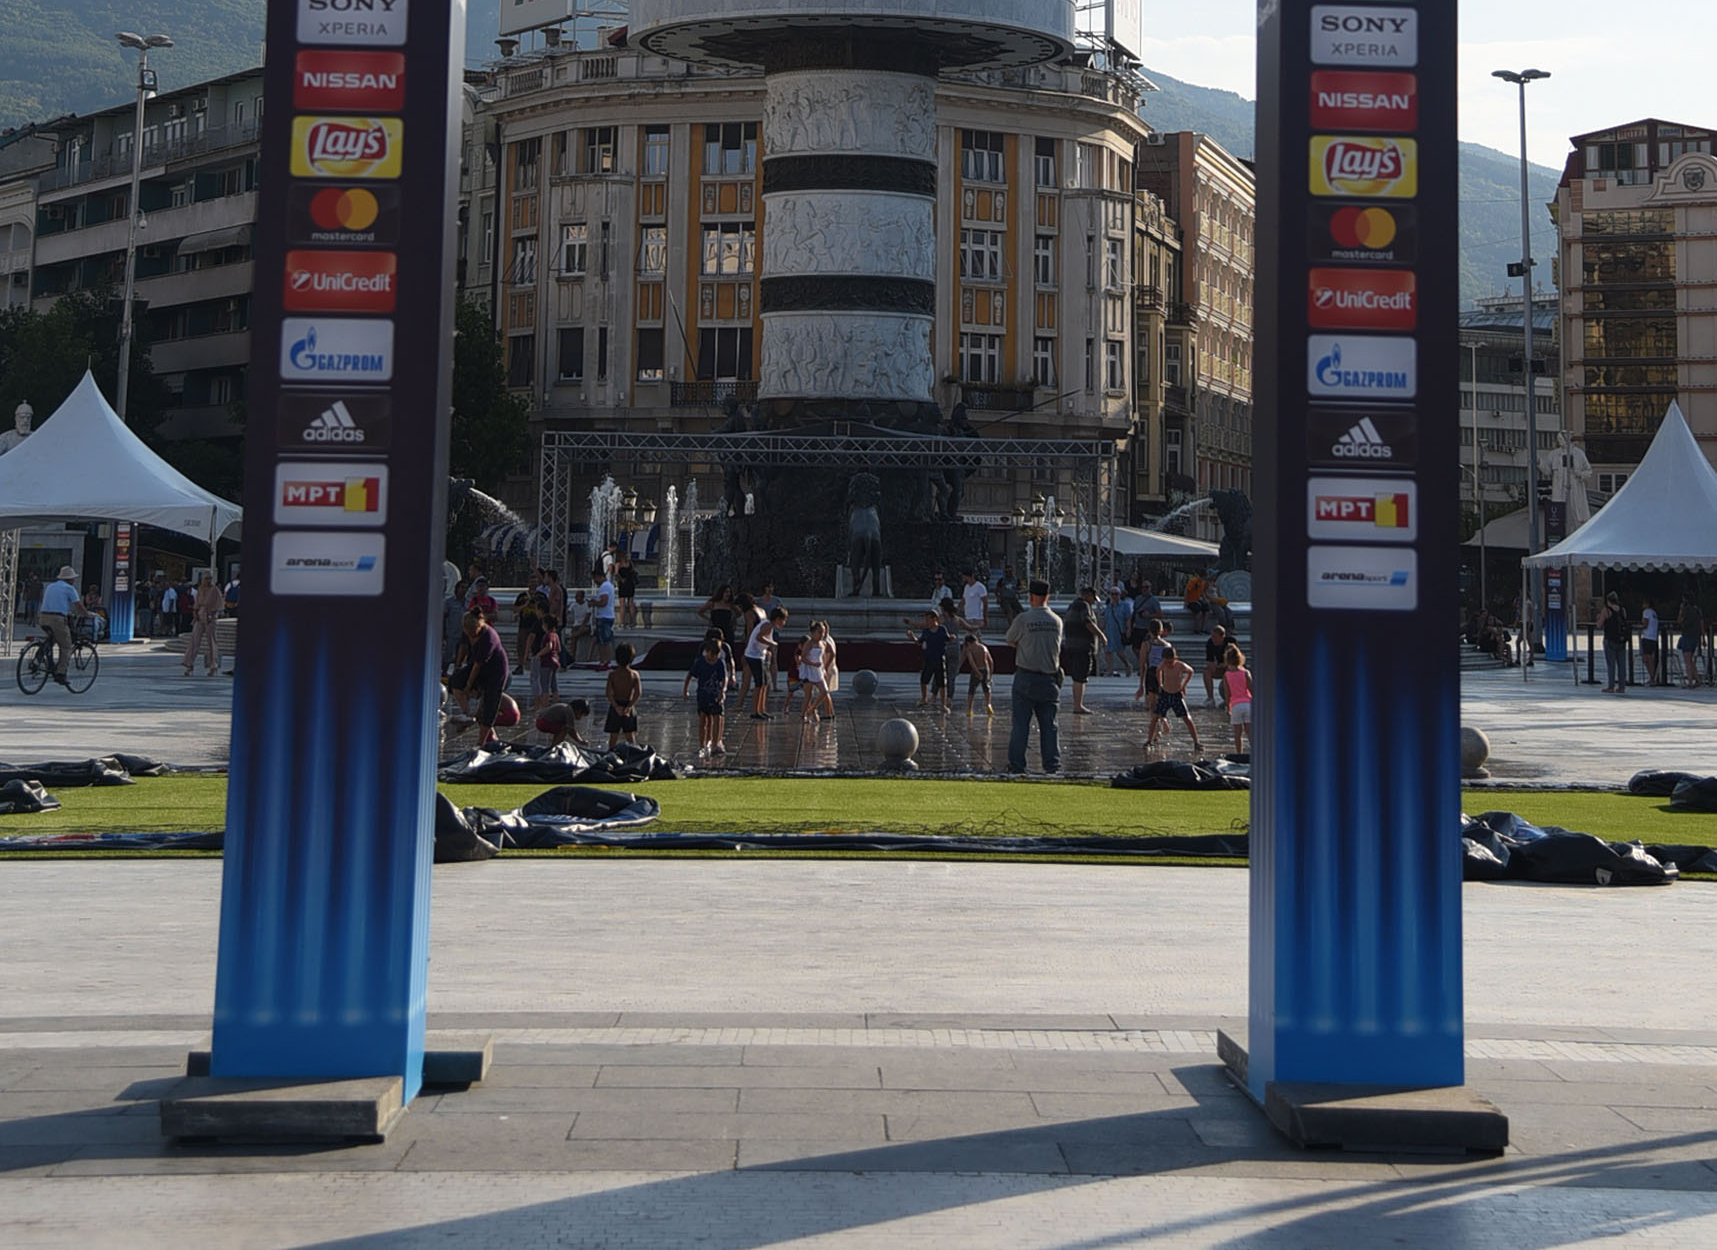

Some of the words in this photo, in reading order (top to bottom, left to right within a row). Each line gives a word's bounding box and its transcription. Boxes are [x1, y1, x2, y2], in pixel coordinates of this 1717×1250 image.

[319, 22, 388, 36] XPERIA
[1320, 15, 1409, 33] SONY
[1330, 42, 1399, 57] XPERIA
[303, 72, 397, 89] NISSAN
[1318, 92, 1409, 110] NISSAN
[312, 124, 383, 161] Lay's
[1330, 144, 1397, 179] Lay's
[312, 231, 375, 242] mastercard
[1331, 250, 1394, 260] mastercard
[313, 272, 391, 292] UniCredit
[1335, 290, 1412, 310] UniCredit
[317, 353, 384, 372] GAZPROM
[1342, 370, 1407, 388] GAZPROM
[303, 426, 365, 442] adidas
[1331, 442, 1392, 458] adidas
